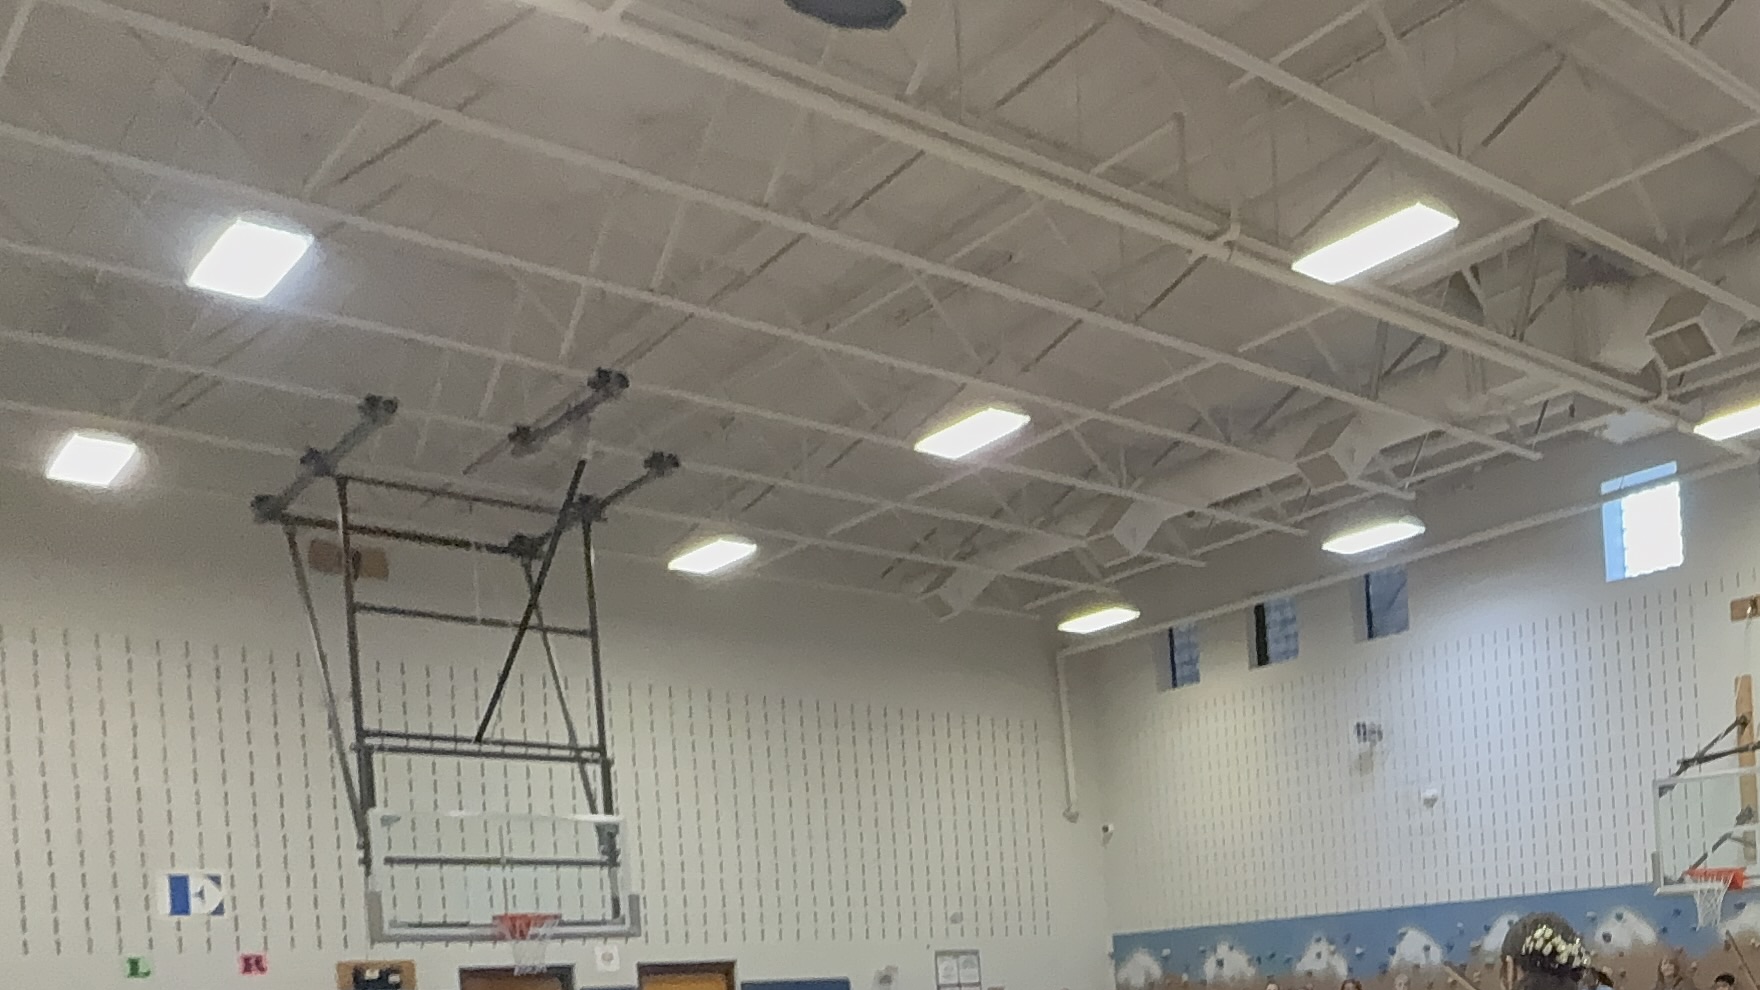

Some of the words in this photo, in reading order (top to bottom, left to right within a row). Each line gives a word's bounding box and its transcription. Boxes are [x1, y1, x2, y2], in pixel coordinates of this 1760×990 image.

[167, 873, 225, 916] E
[127, 957, 151, 979] L
[240, 954, 268, 975] R
